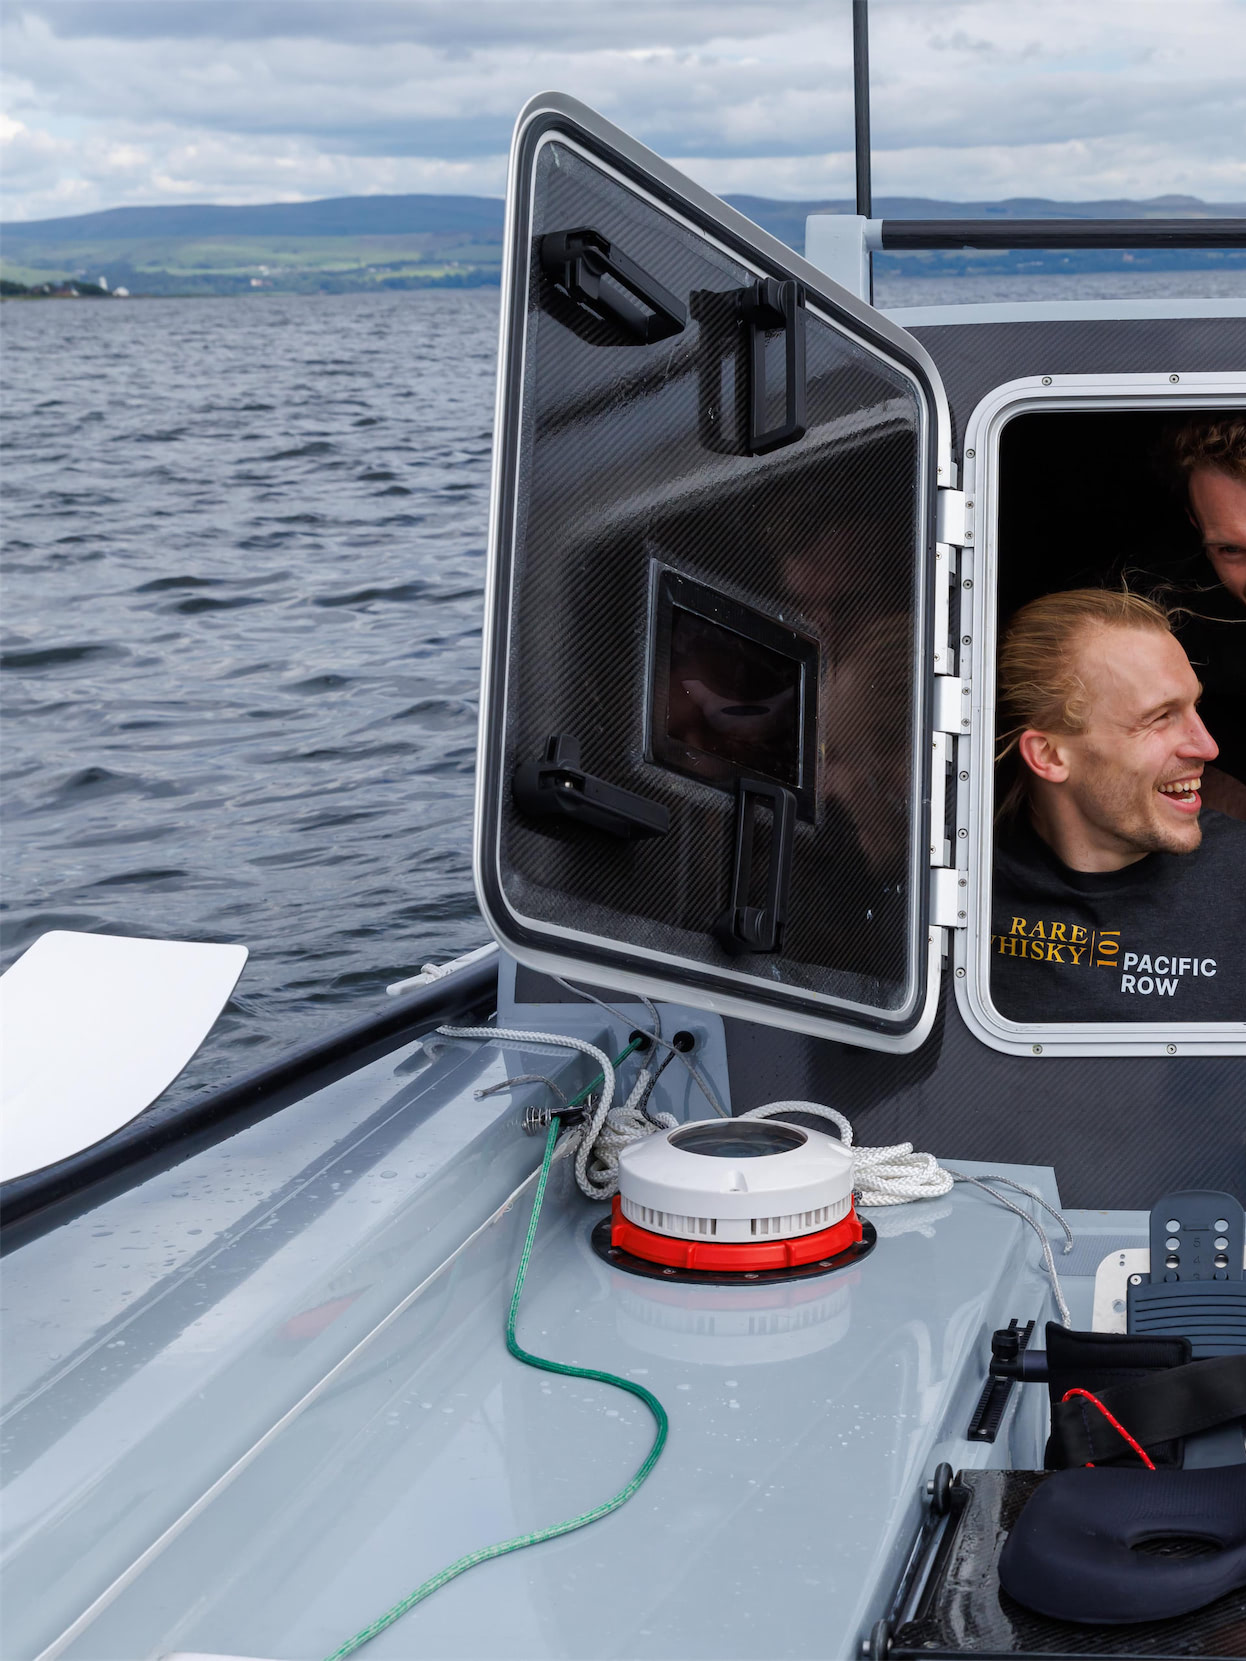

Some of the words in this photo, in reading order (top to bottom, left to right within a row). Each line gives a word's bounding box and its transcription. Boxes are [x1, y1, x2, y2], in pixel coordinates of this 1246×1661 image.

[1009, 916, 1089, 945] RARE
[1097, 931, 1121, 967] 101
[1123, 952, 1217, 977] PACIFIC
[1120, 974, 1179, 996] ROW
